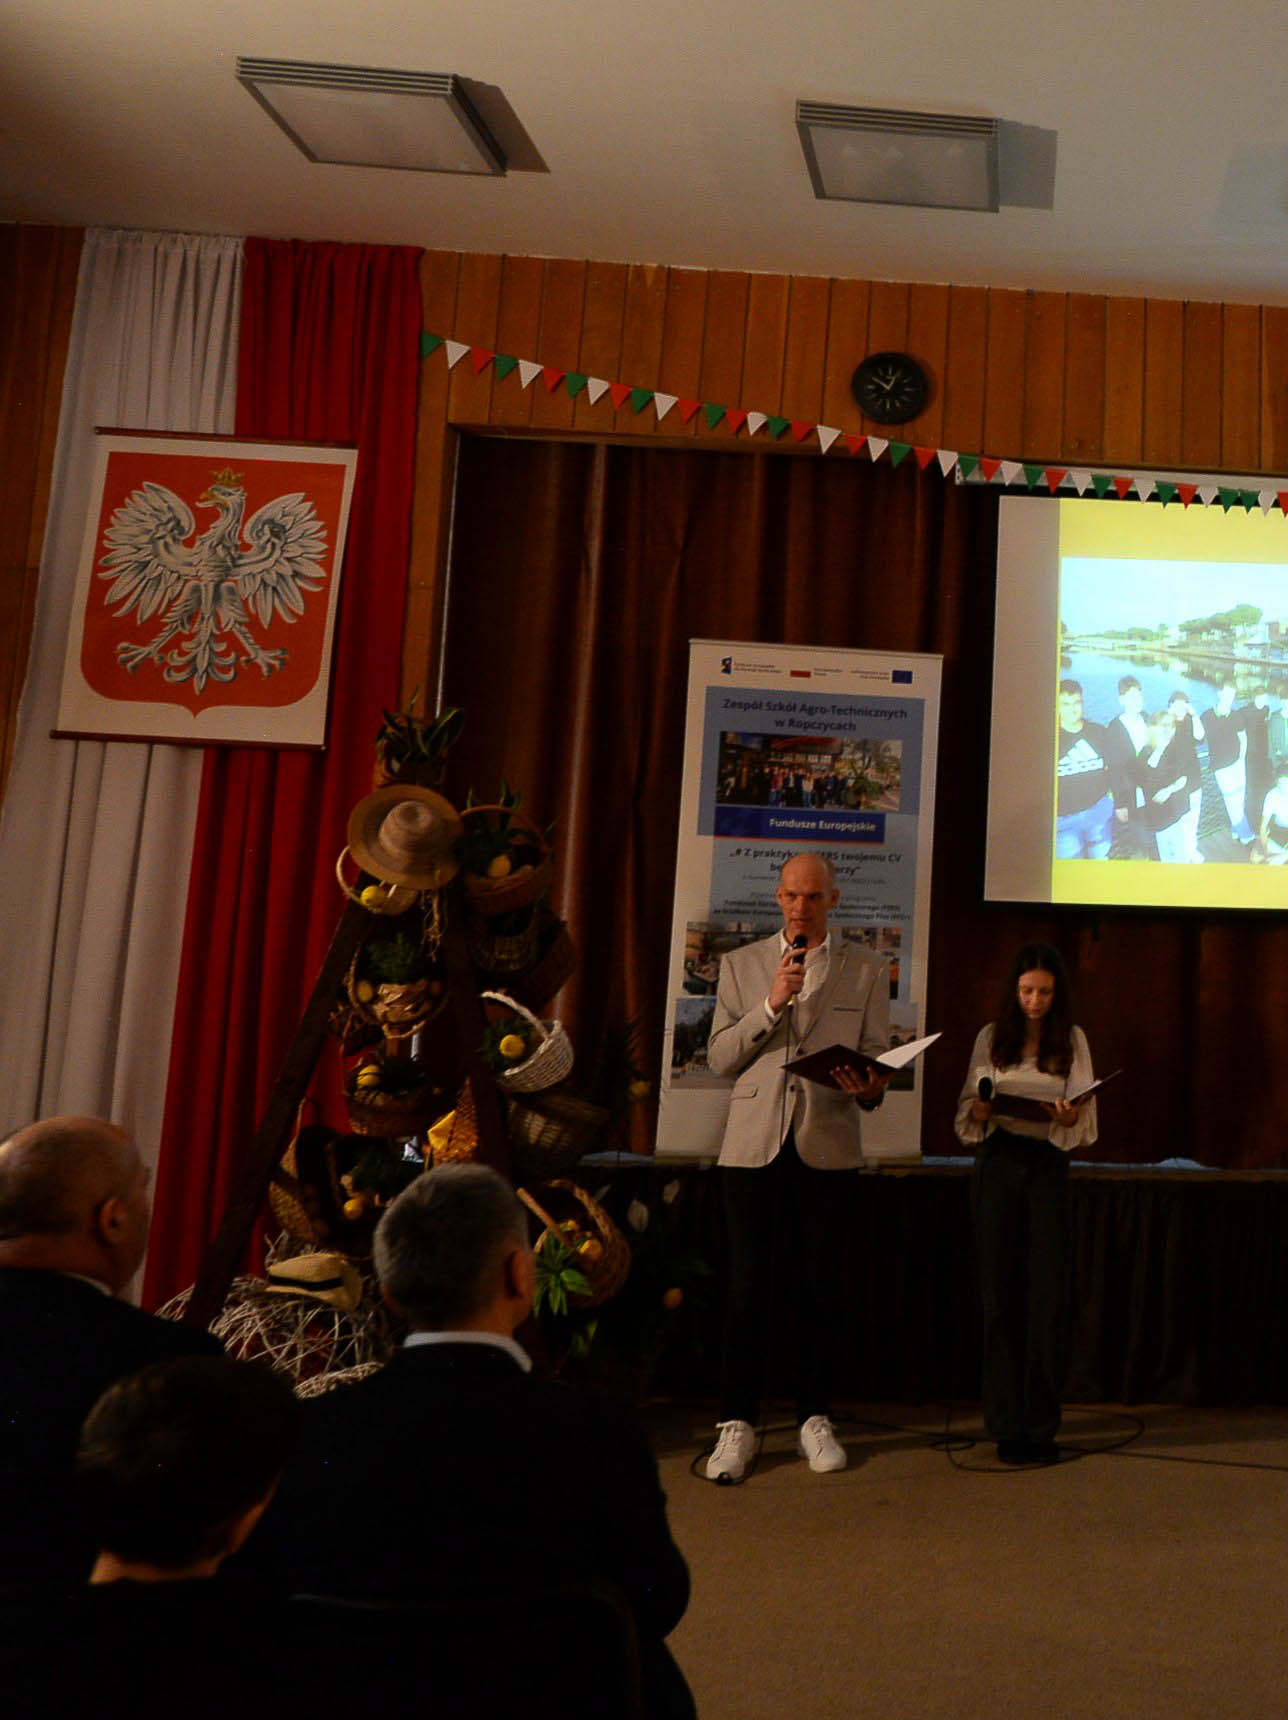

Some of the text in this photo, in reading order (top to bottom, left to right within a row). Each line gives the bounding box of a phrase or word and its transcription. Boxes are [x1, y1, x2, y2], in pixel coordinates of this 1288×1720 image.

[722, 699, 907, 720] Zespół Szkół Agro-Technicznych
[775, 718, 857, 732] w Ropczycach
[769, 818, 877, 833] Fundusze Europejskie
[753, 849, 799, 860] praktyk
[841, 852, 886, 864] twojemu
[888, 853, 903, 863] CV
